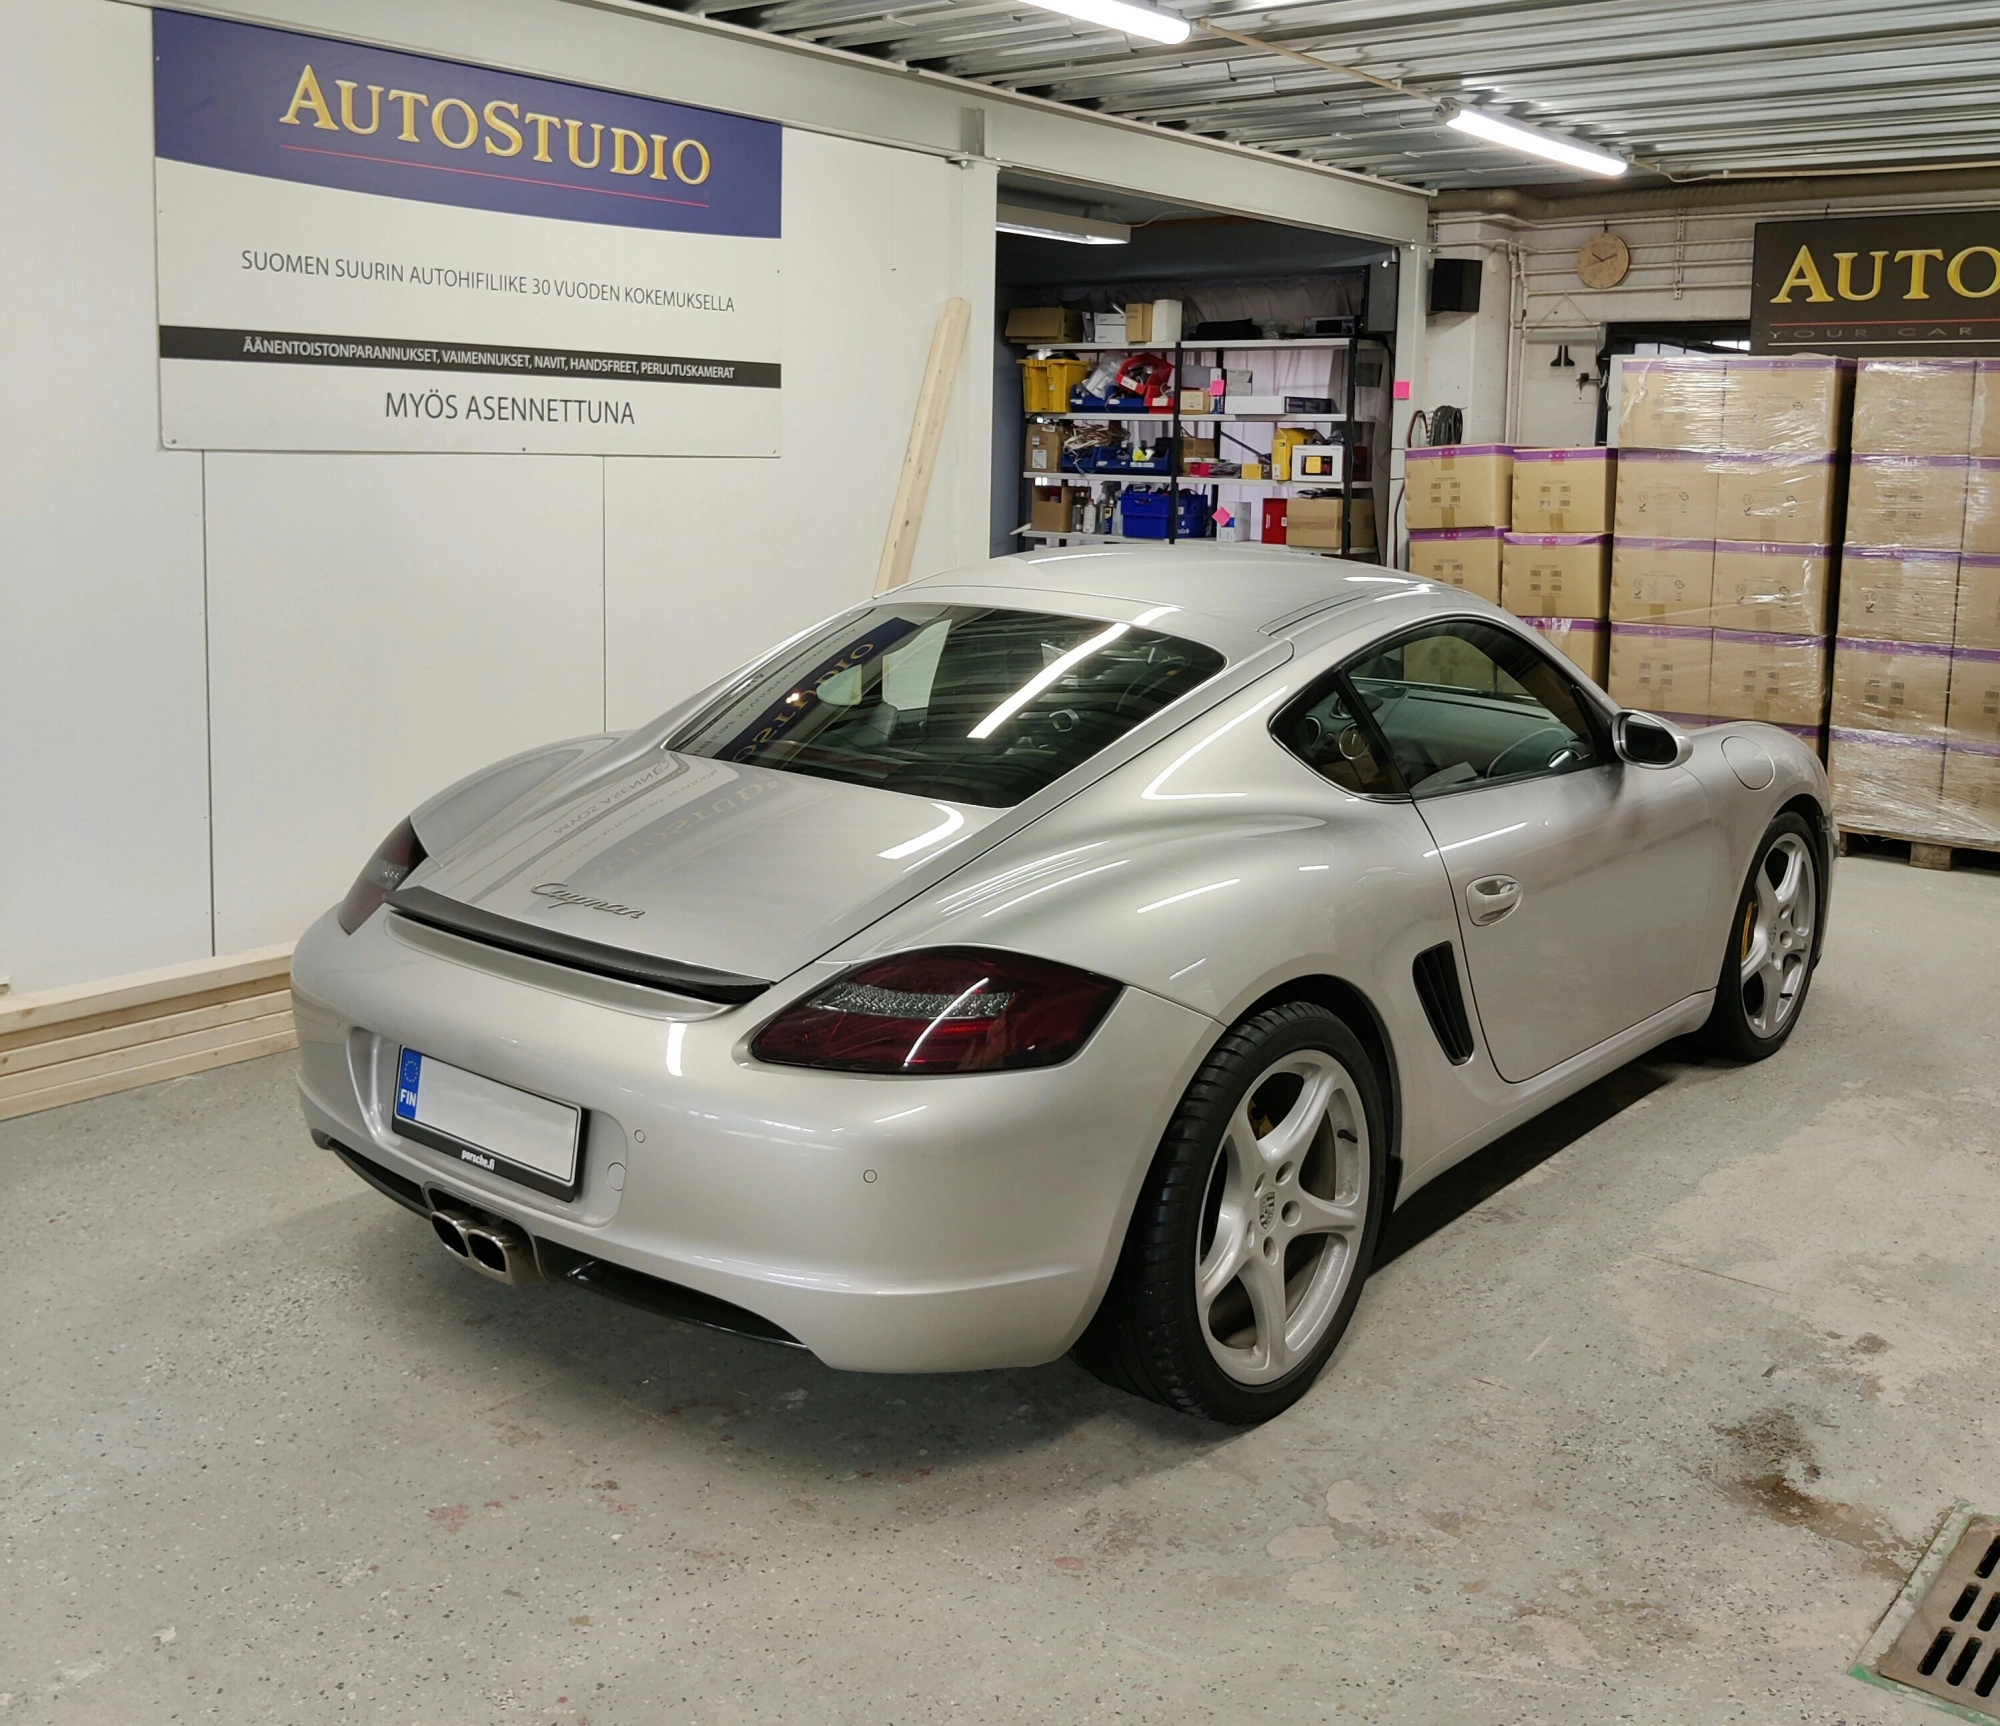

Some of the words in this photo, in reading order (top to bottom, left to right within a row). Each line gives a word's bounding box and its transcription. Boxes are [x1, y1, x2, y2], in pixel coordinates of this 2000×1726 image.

[241, 250, 329, 276] SUOMEN
[335, 258, 404, 282] SUURIN
[409, 266, 528, 294] AUTOHIFILIIKE
[532, 278, 551, 296] 30
[554, 279, 621, 302] VUODEN
[624, 286, 735, 312] KOKEMUKSELLA
[1769, 244, 2000, 304] AUTO
[1769, 329, 1867, 339] YOUR
[1898, 326, 1973, 336] CAR
[242, 335, 441, 364] ÄÄNENTOISTONPARANNUKSET,
[441, 349, 532, 369] VAIMENNUKSET,
[534, 355, 568, 371] NAVIT,
[570, 357, 639, 375] HANDSFREET,
[641, 361, 735, 379] PERUUTUSKAMERAT
[386, 388, 458, 419] MYÖS
[465, 395, 636, 425] ASENNETTUNA
[530, 882, 646, 920] Cayman
[400, 1088, 417, 1107] FIN
[461, 1149, 495, 1171] porsche.fi
